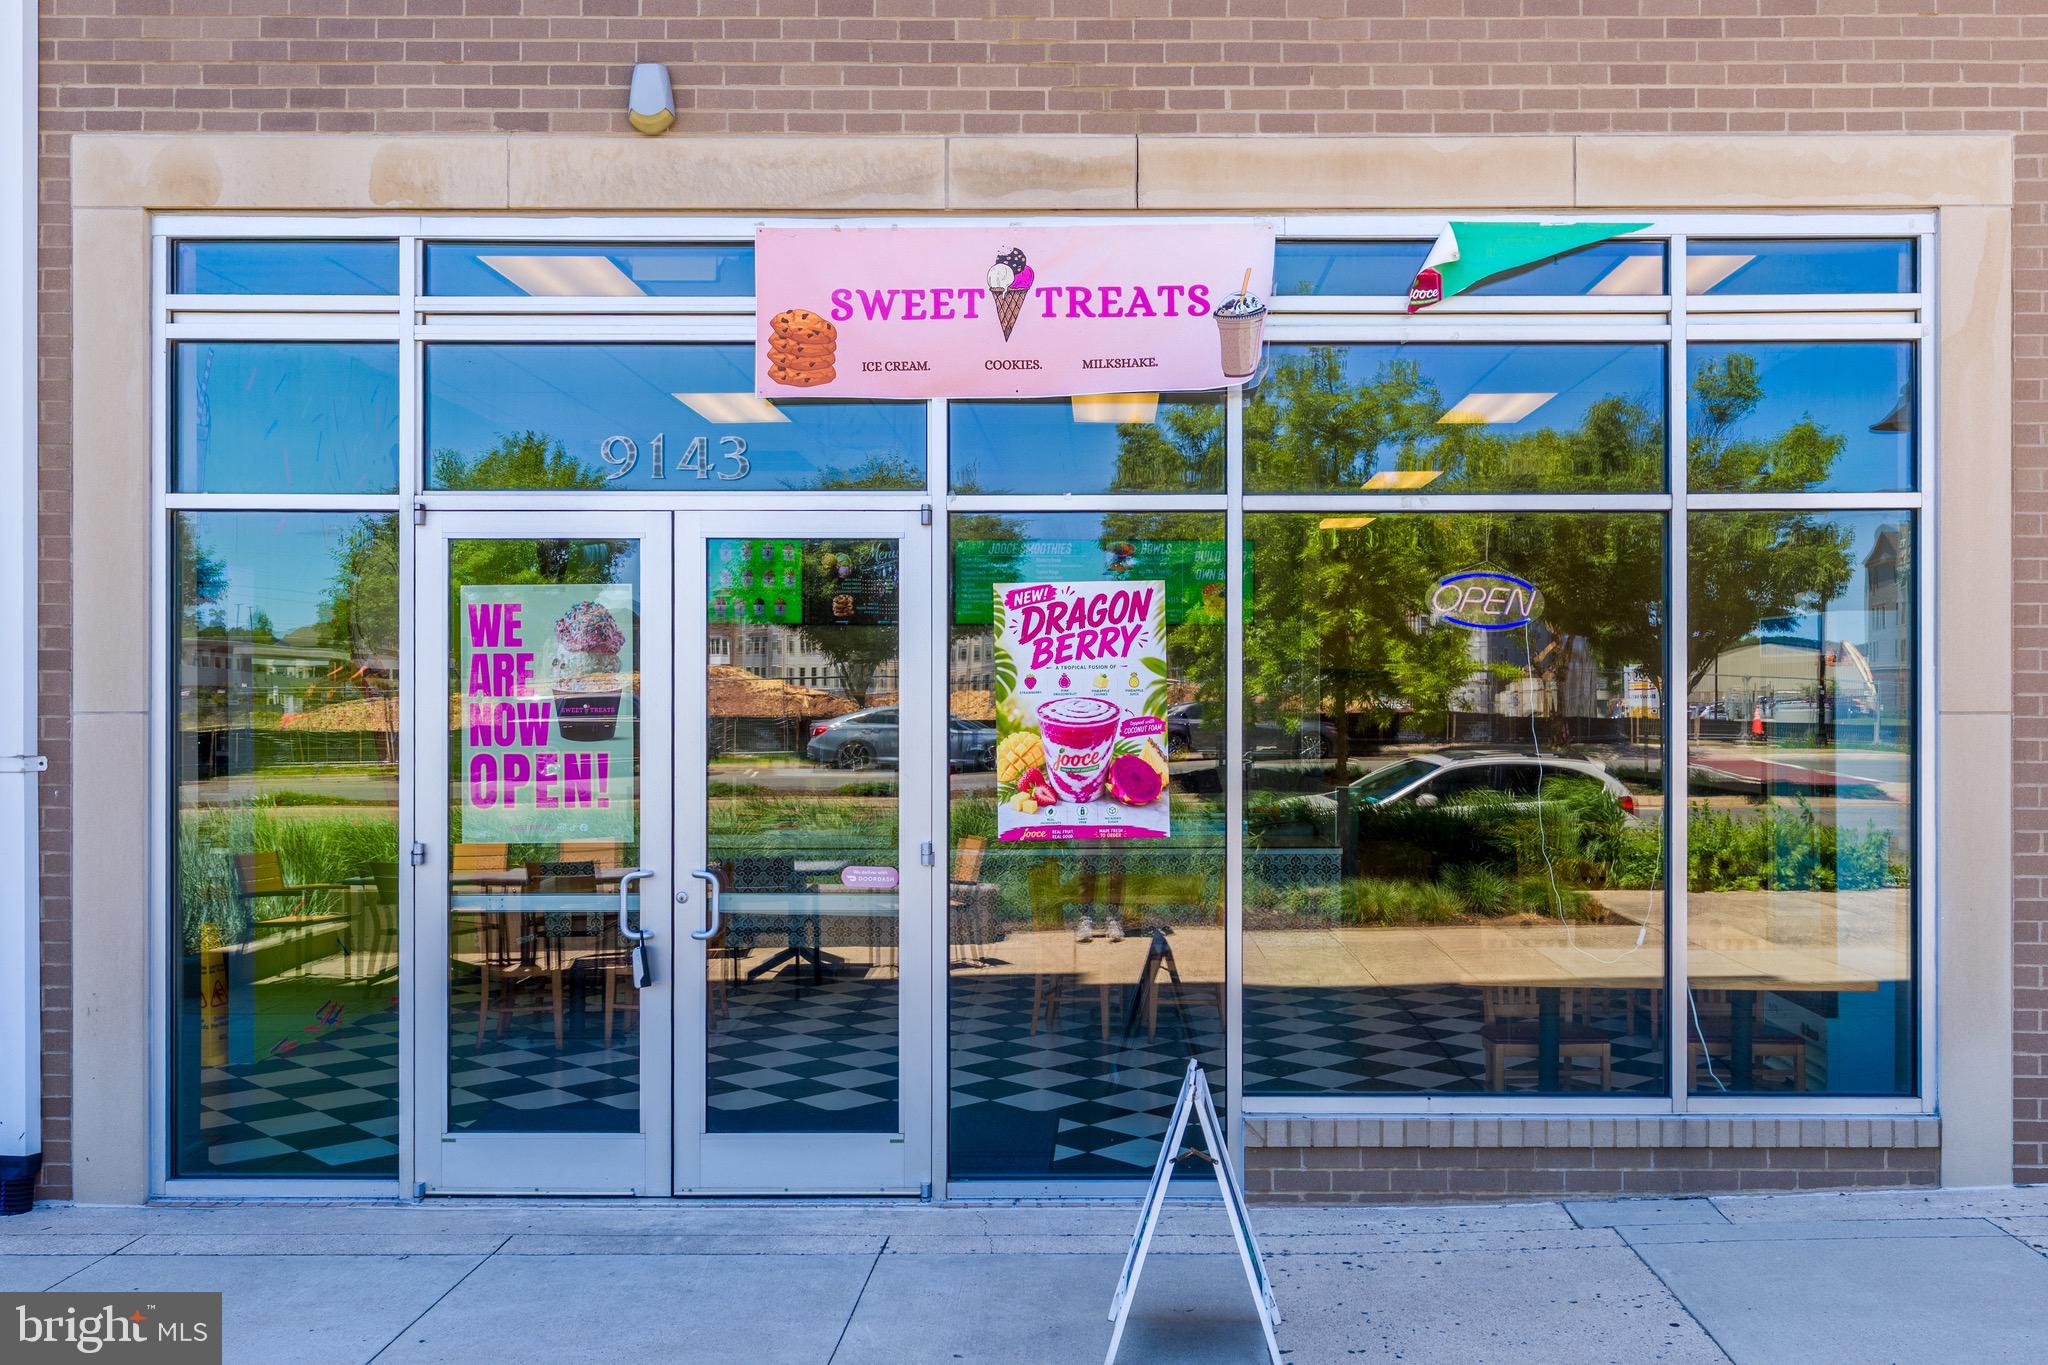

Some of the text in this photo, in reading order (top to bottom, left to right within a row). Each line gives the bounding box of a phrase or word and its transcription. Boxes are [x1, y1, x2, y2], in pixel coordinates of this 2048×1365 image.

[831, 284, 1211, 322] SWEET TREATS
[862, 360, 931, 372] ICE CREAM.
[984, 359, 1043, 371] COOKIES.
[1082, 357, 1159, 370] MILKSHAKE.
[601, 432, 751, 481] 9143
[1140, 543, 1173, 555] BOWLS
[1013, 587, 1049, 607] NEW!
[1432, 584, 1537, 617] OPEN
[468, 603, 523, 648] WE
[1018, 587, 1154, 645] DRAGON
[1030, 624, 1143, 670] BERRY
[468, 652, 535, 697] ARE
[469, 702, 552, 747] NOW
[1124, 723, 1163, 734] COCONUT FOAM
[1053, 749, 1100, 771] jooce
[469, 753, 610, 809] OPEN!
[1020, 828, 1047, 840] jooce
